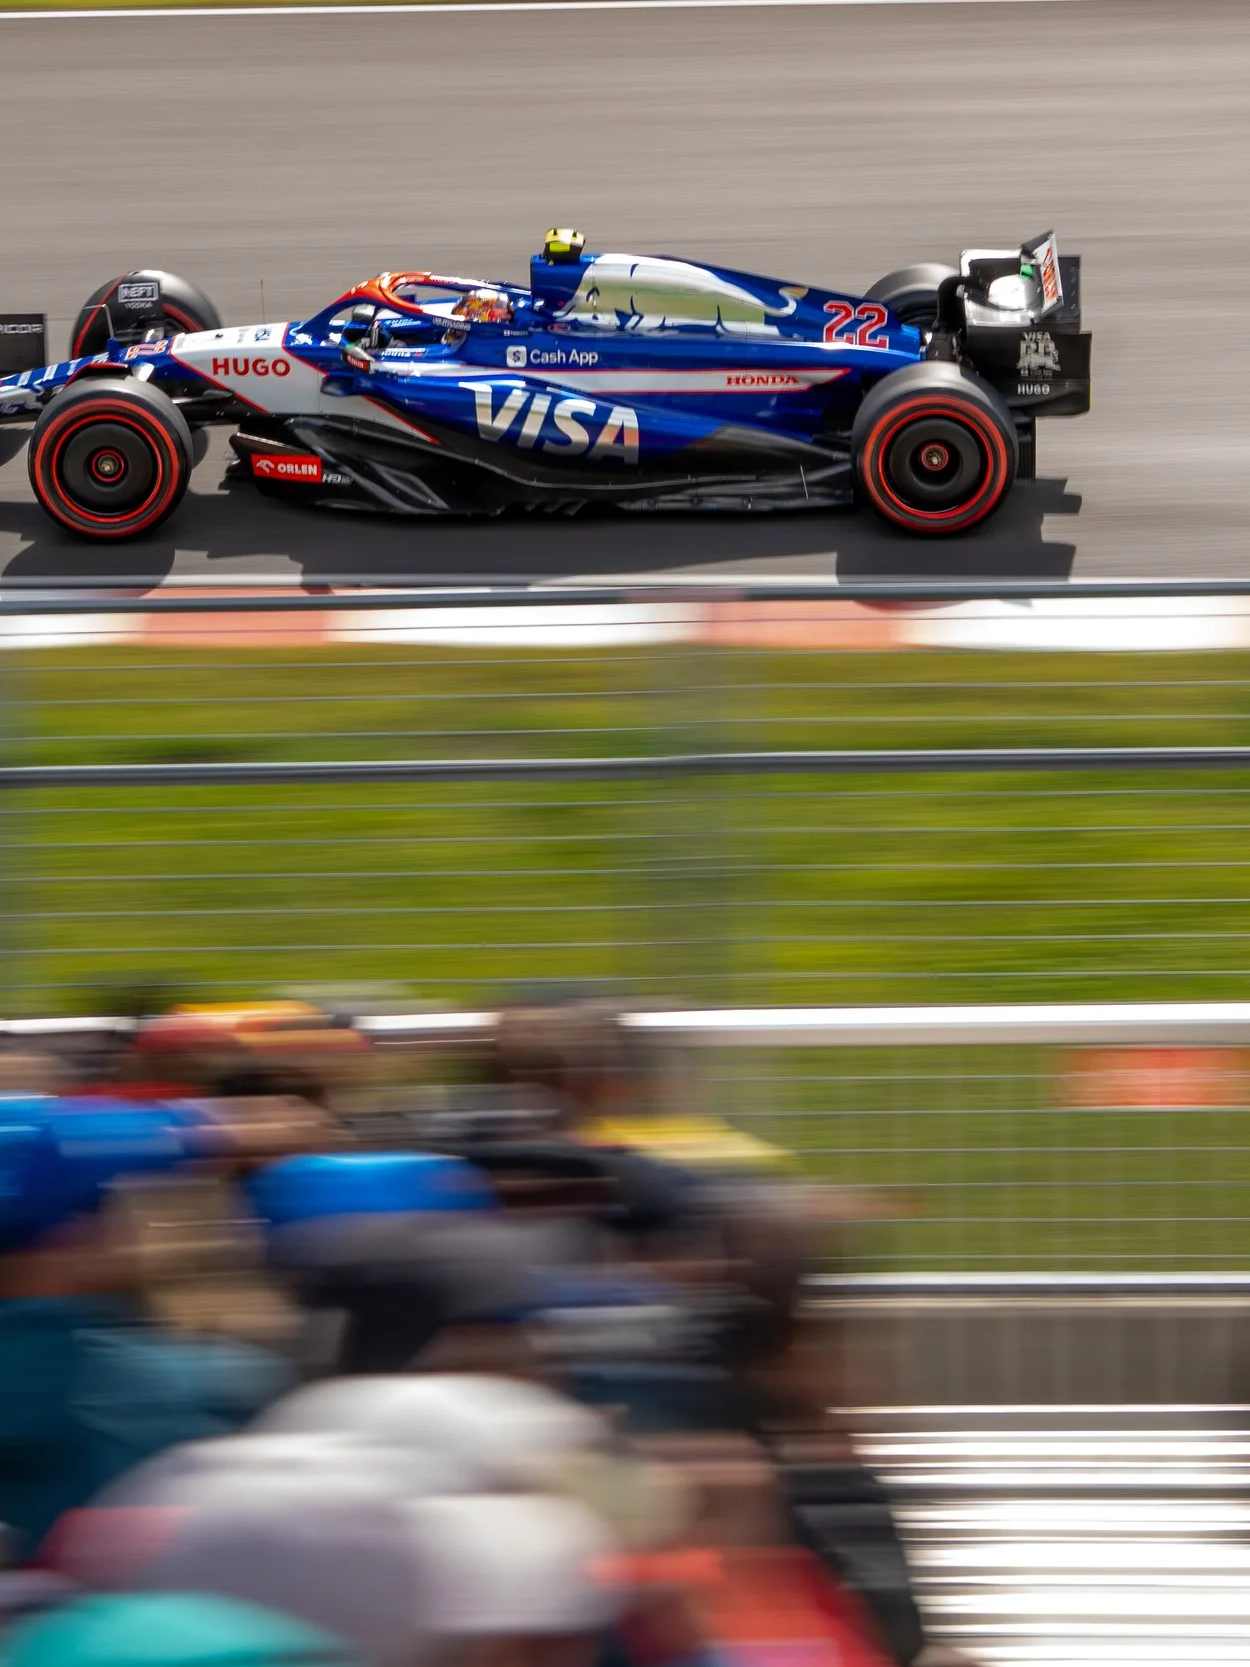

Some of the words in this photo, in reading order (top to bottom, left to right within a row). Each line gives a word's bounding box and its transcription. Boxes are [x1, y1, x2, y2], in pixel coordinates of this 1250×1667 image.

[823, 301, 889, 349] 22
[530, 349, 566, 364] Cash
[568, 349, 599, 366] App
[212, 358, 291, 377] HUGO
[726, 375, 799, 386] HONDA
[1017, 384, 1050, 395] HUGO
[458, 380, 640, 465] VISA
[277, 463, 317, 475] ORLEN
